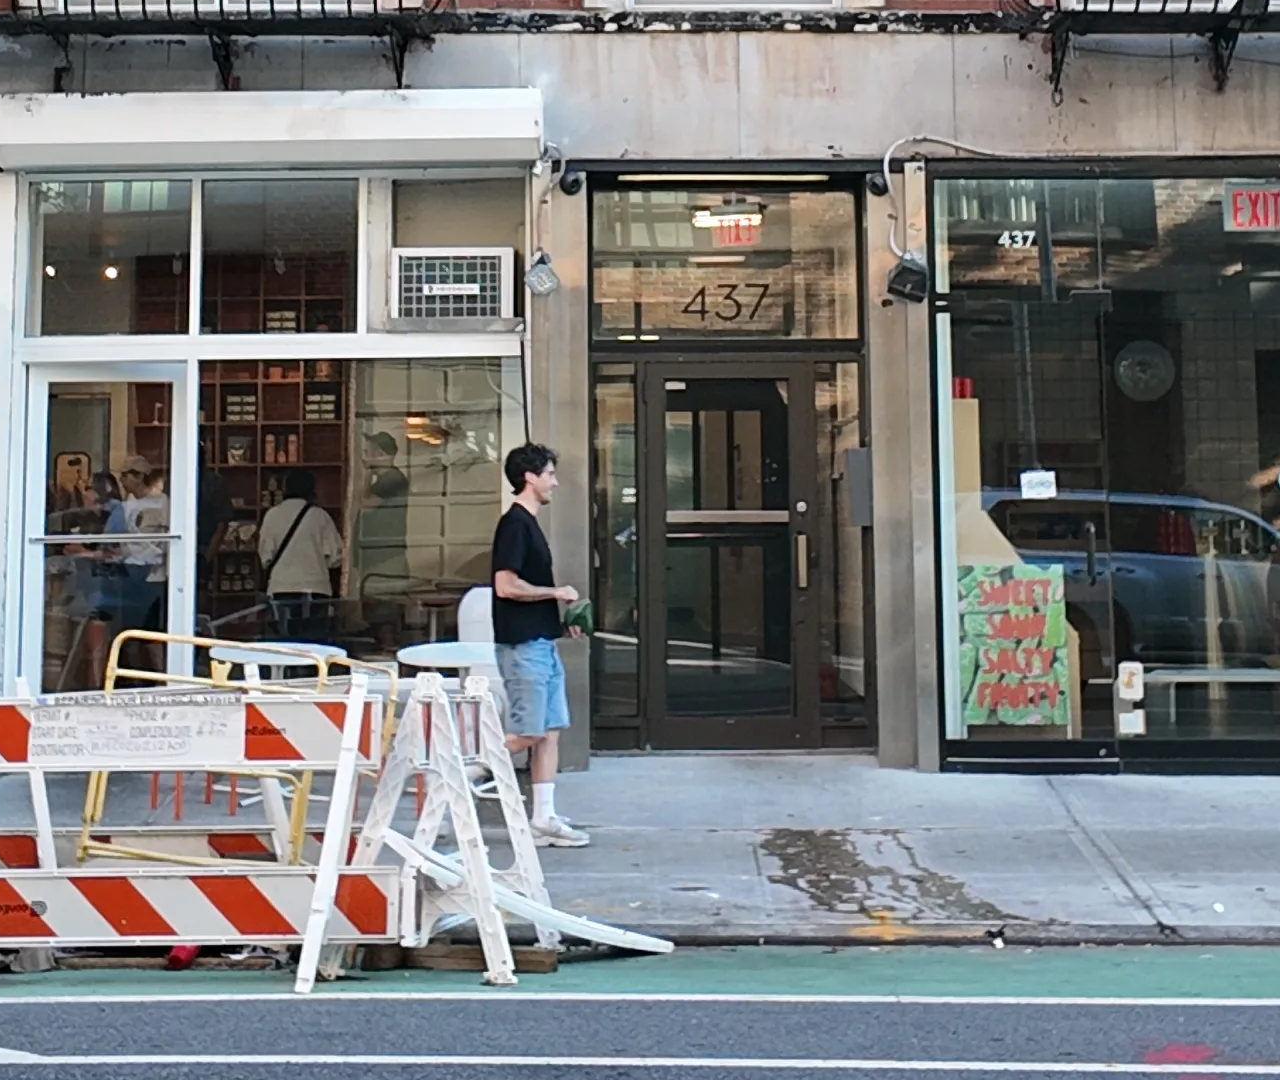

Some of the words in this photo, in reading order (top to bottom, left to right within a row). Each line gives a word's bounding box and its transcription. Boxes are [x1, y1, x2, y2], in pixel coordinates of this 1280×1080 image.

[998, 230, 1037, 249] 437
[681, 283, 770, 322] 437
[976, 579, 1052, 607] SWEET
[981, 647, 1055, 675] SALTY
[976, 681, 1061, 709] FRUITY
